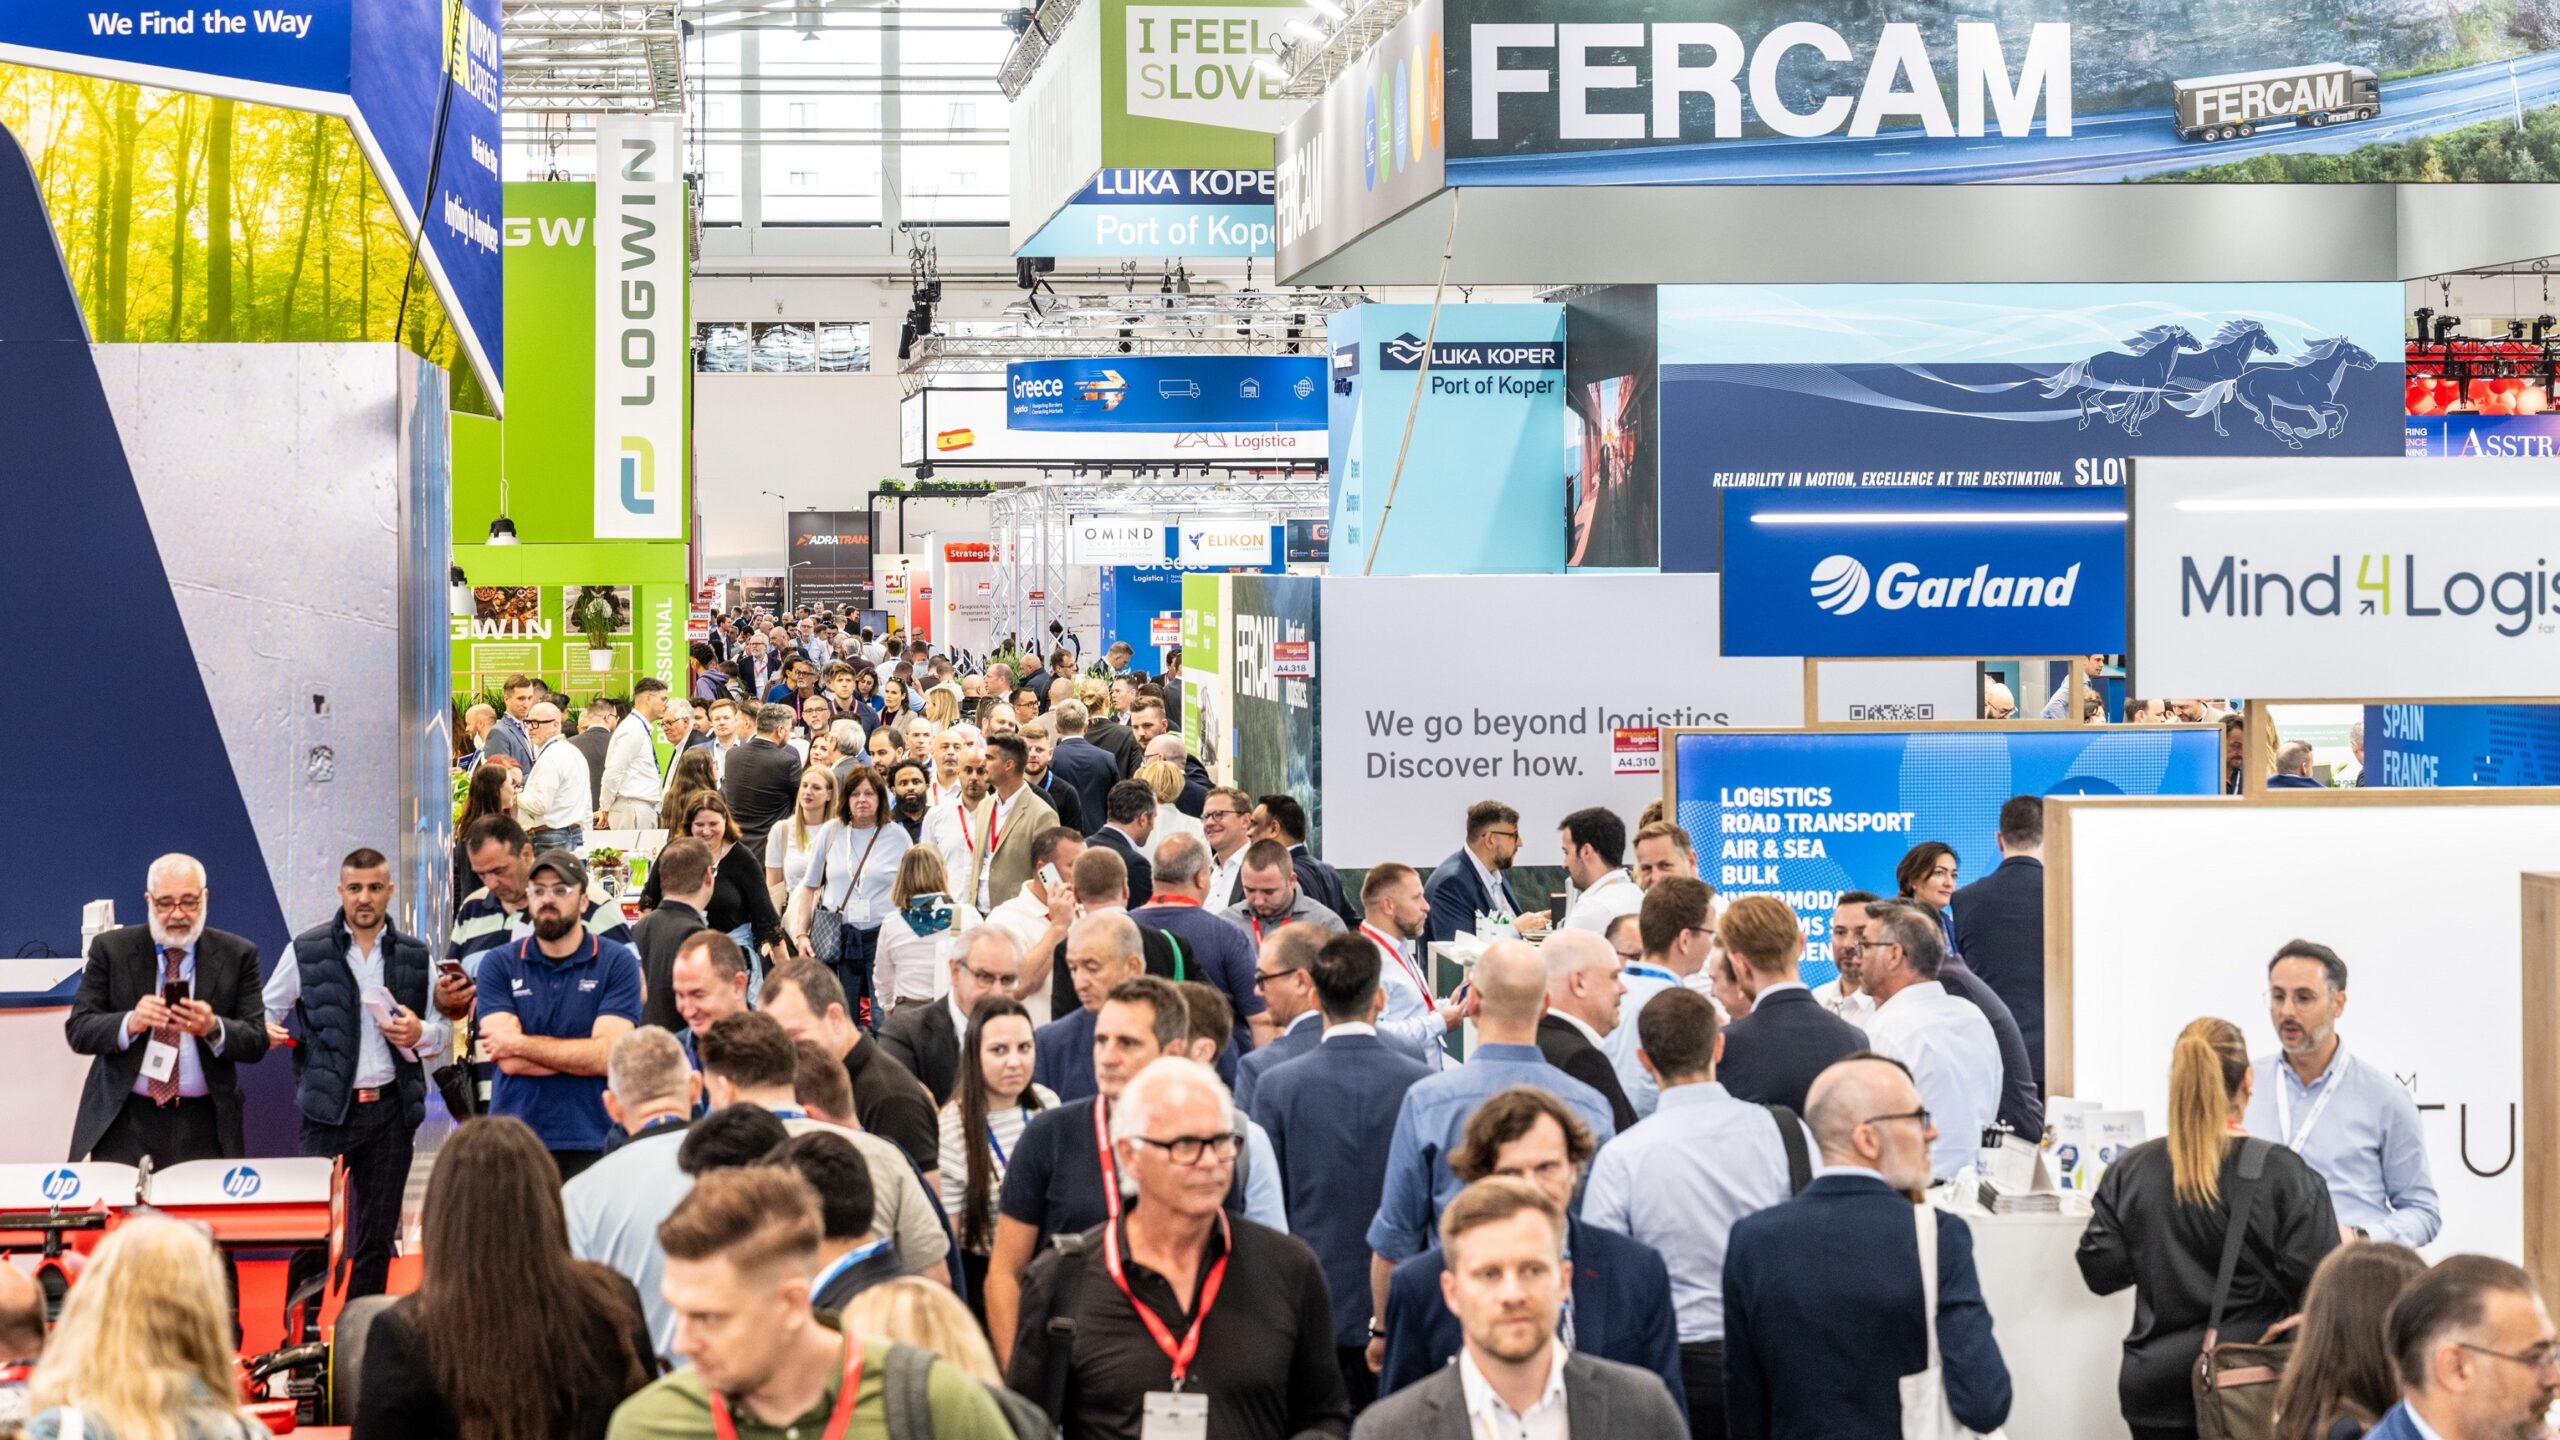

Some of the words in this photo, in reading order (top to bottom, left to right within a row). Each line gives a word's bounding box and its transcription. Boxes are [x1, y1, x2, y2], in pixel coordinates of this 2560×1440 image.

[88, 12, 133, 36] We
[140, 9, 194, 35] Find
[202, 9, 246, 34] the
[253, 9, 313, 39] Way
[1138, 18, 1156, 54] I
[1170, 18, 1273, 54] FEEL
[470, 11, 498, 73] NIPPON
[470, 58, 498, 115] EXPRESS
[1471, 21, 2072, 141] FERCAM
[2195, 73, 2345, 126] FERCAM
[1096, 169, 1181, 195] LUKA
[1276, 131, 1324, 252] FERCAM
[1096, 214, 1160, 245] Port
[1167, 213, 1200, 245] of
[620, 138, 656, 407] LOGWIN
[1431, 348, 1483, 365] LUKA
[1487, 347, 1556, 364] KOPER
[1013, 374, 1064, 399] Greece
[1431, 375, 1470, 394] Port
[1474, 375, 1493, 394] of
[1499, 375, 1554, 398] Koper
[1235, 433, 1297, 451] Logística
[2461, 427, 2560, 458] ASSTR
[1712, 471, 1785, 488] RELIABILITY
[1788, 471, 1802, 487] IN
[1805, 471, 1858, 489] MOTION,
[1861, 471, 1934, 487] EXCELLENCE
[1937, 471, 1954, 486] AT
[1956, 471, 1980, 486] THE
[1982, 470, 2064, 487] DESTINATION.
[1085, 527, 1153, 540] OMIND
[1208, 534, 1265, 548] ELIKON
[1133, 575, 1164, 583] Logistics
[1875, 560, 2081, 610] Garland
[1277, 664, 1307, 673] A4.318
[1365, 709, 1414, 737] We
[1424, 714, 1463, 743] go
[1474, 707, 1587, 742] beyond
[2383, 704, 2424, 742] SPAIN
[1366, 751, 1504, 779] Discover
[1513, 749, 1584, 777] how.
[1618, 757, 1656, 767] A4.310
[2383, 749, 2439, 787] FRANCE
[1720, 787, 1832, 808] LOGISTICS
[1721, 813, 1781, 834] ROAD
[1784, 812, 1915, 832] TRANSPORT
[1721, 840, 1759, 859] AIR
[1762, 839, 1780, 859] &
[1783, 839, 1827, 859] SEA
[1721, 865, 1780, 885] BULK
[47, 1169, 79, 1201] hp
[228, 1166, 260, 1198] hp
